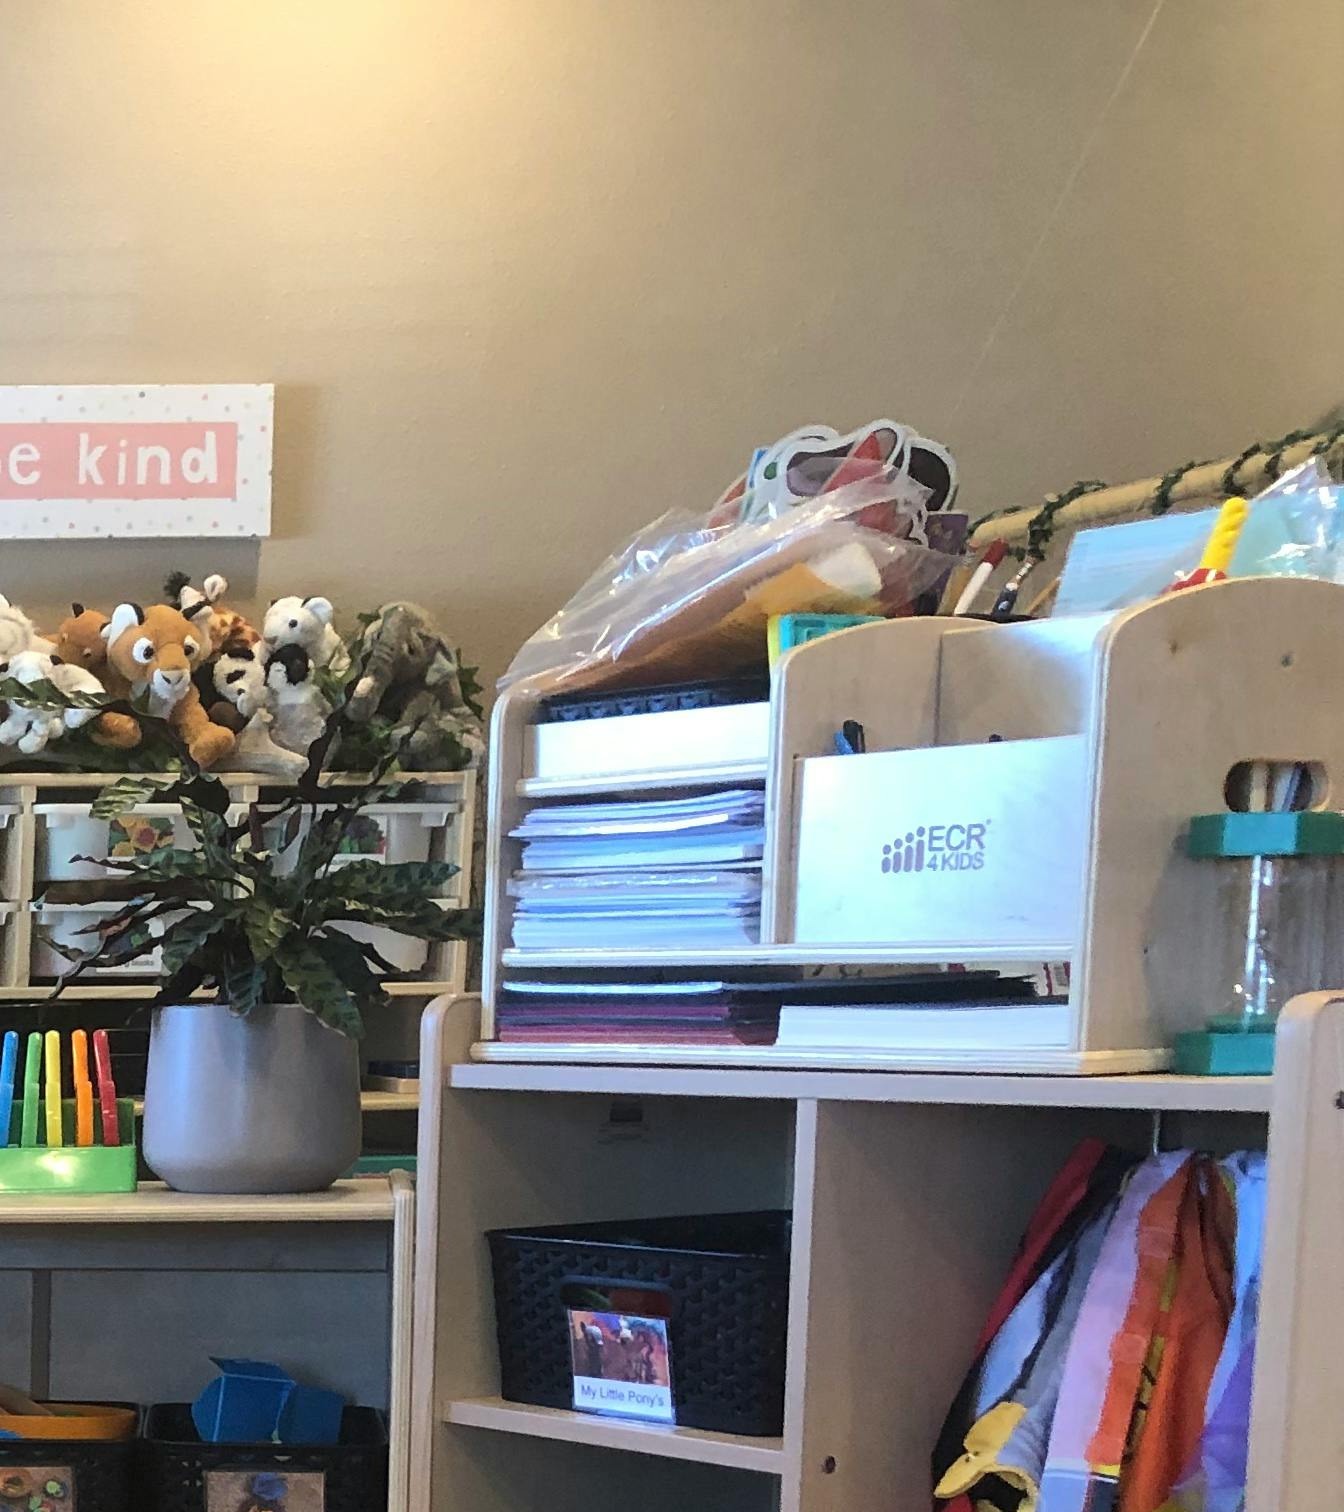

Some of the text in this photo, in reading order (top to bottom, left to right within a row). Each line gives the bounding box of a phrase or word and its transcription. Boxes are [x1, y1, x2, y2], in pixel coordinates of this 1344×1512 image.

[78, 431, 218, 486] kind
[927, 823, 986, 851] ECR
[580, 1384, 665, 1408] My Little Pony's
